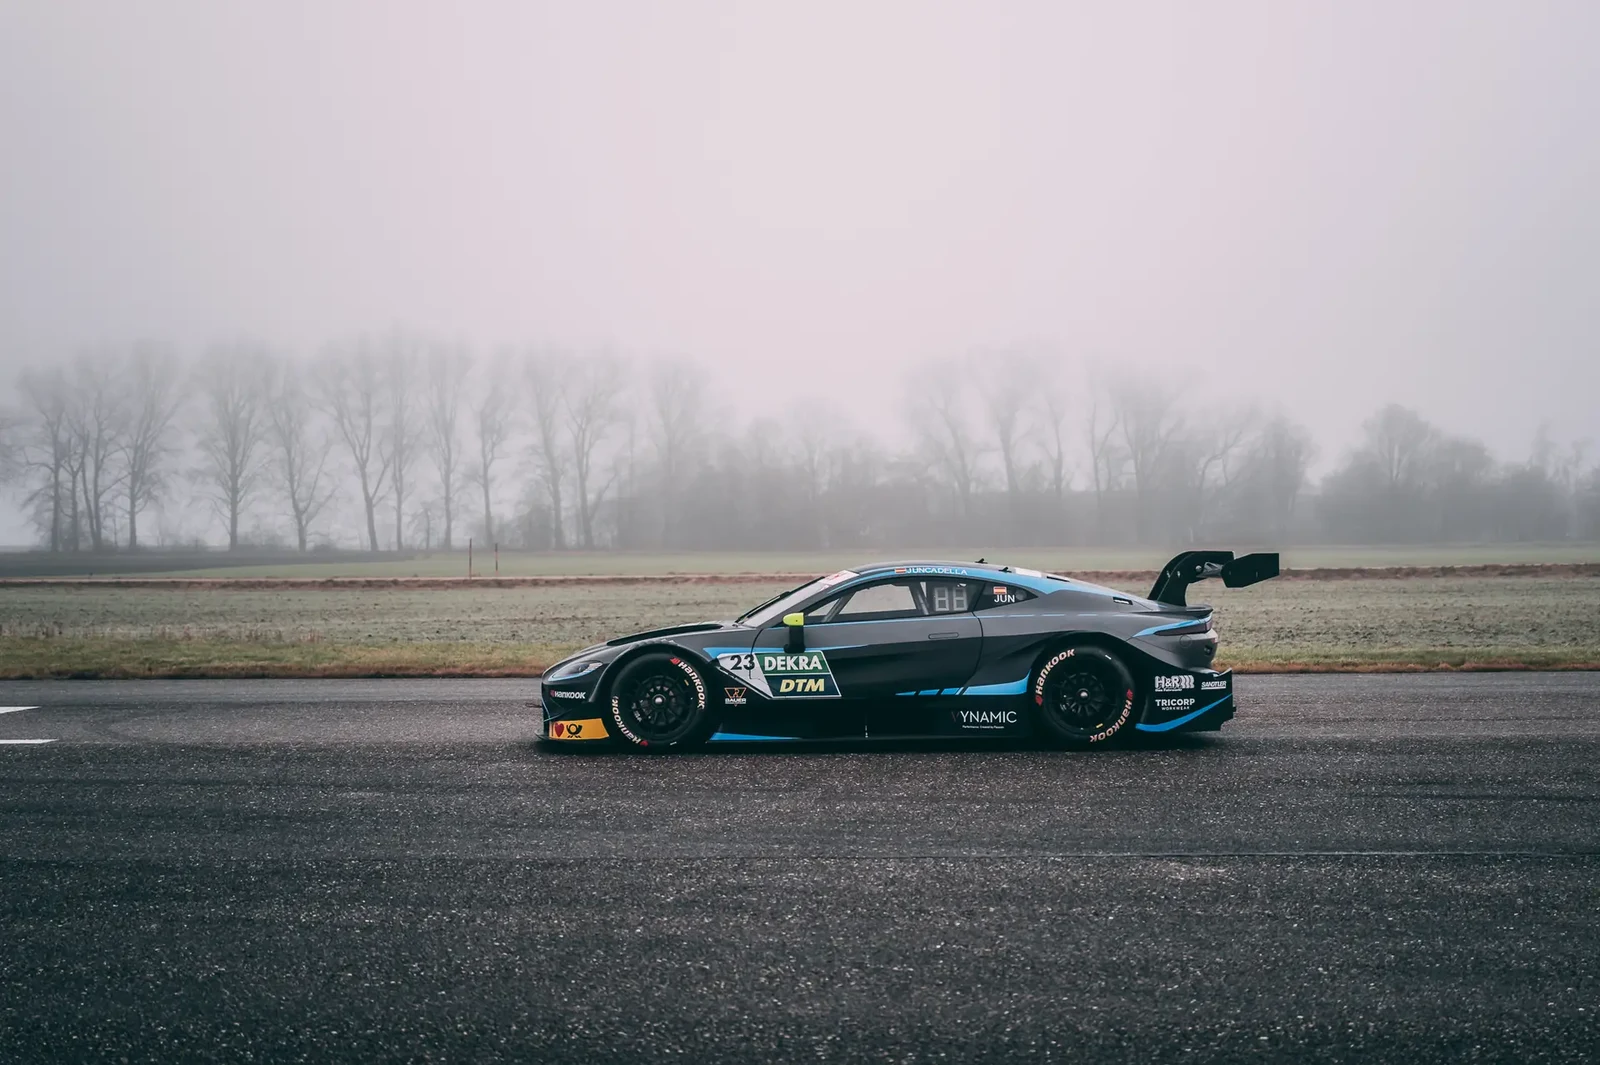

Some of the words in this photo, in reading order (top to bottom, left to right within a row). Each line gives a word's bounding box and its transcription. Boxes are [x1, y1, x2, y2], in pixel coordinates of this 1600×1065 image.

[994, 594, 1015, 603] JUN
[730, 654, 755, 670] 23
[764, 655, 823, 671] DEKRA
[780, 679, 825, 692] DTM
[1155, 698, 1195, 707] TRICORP
